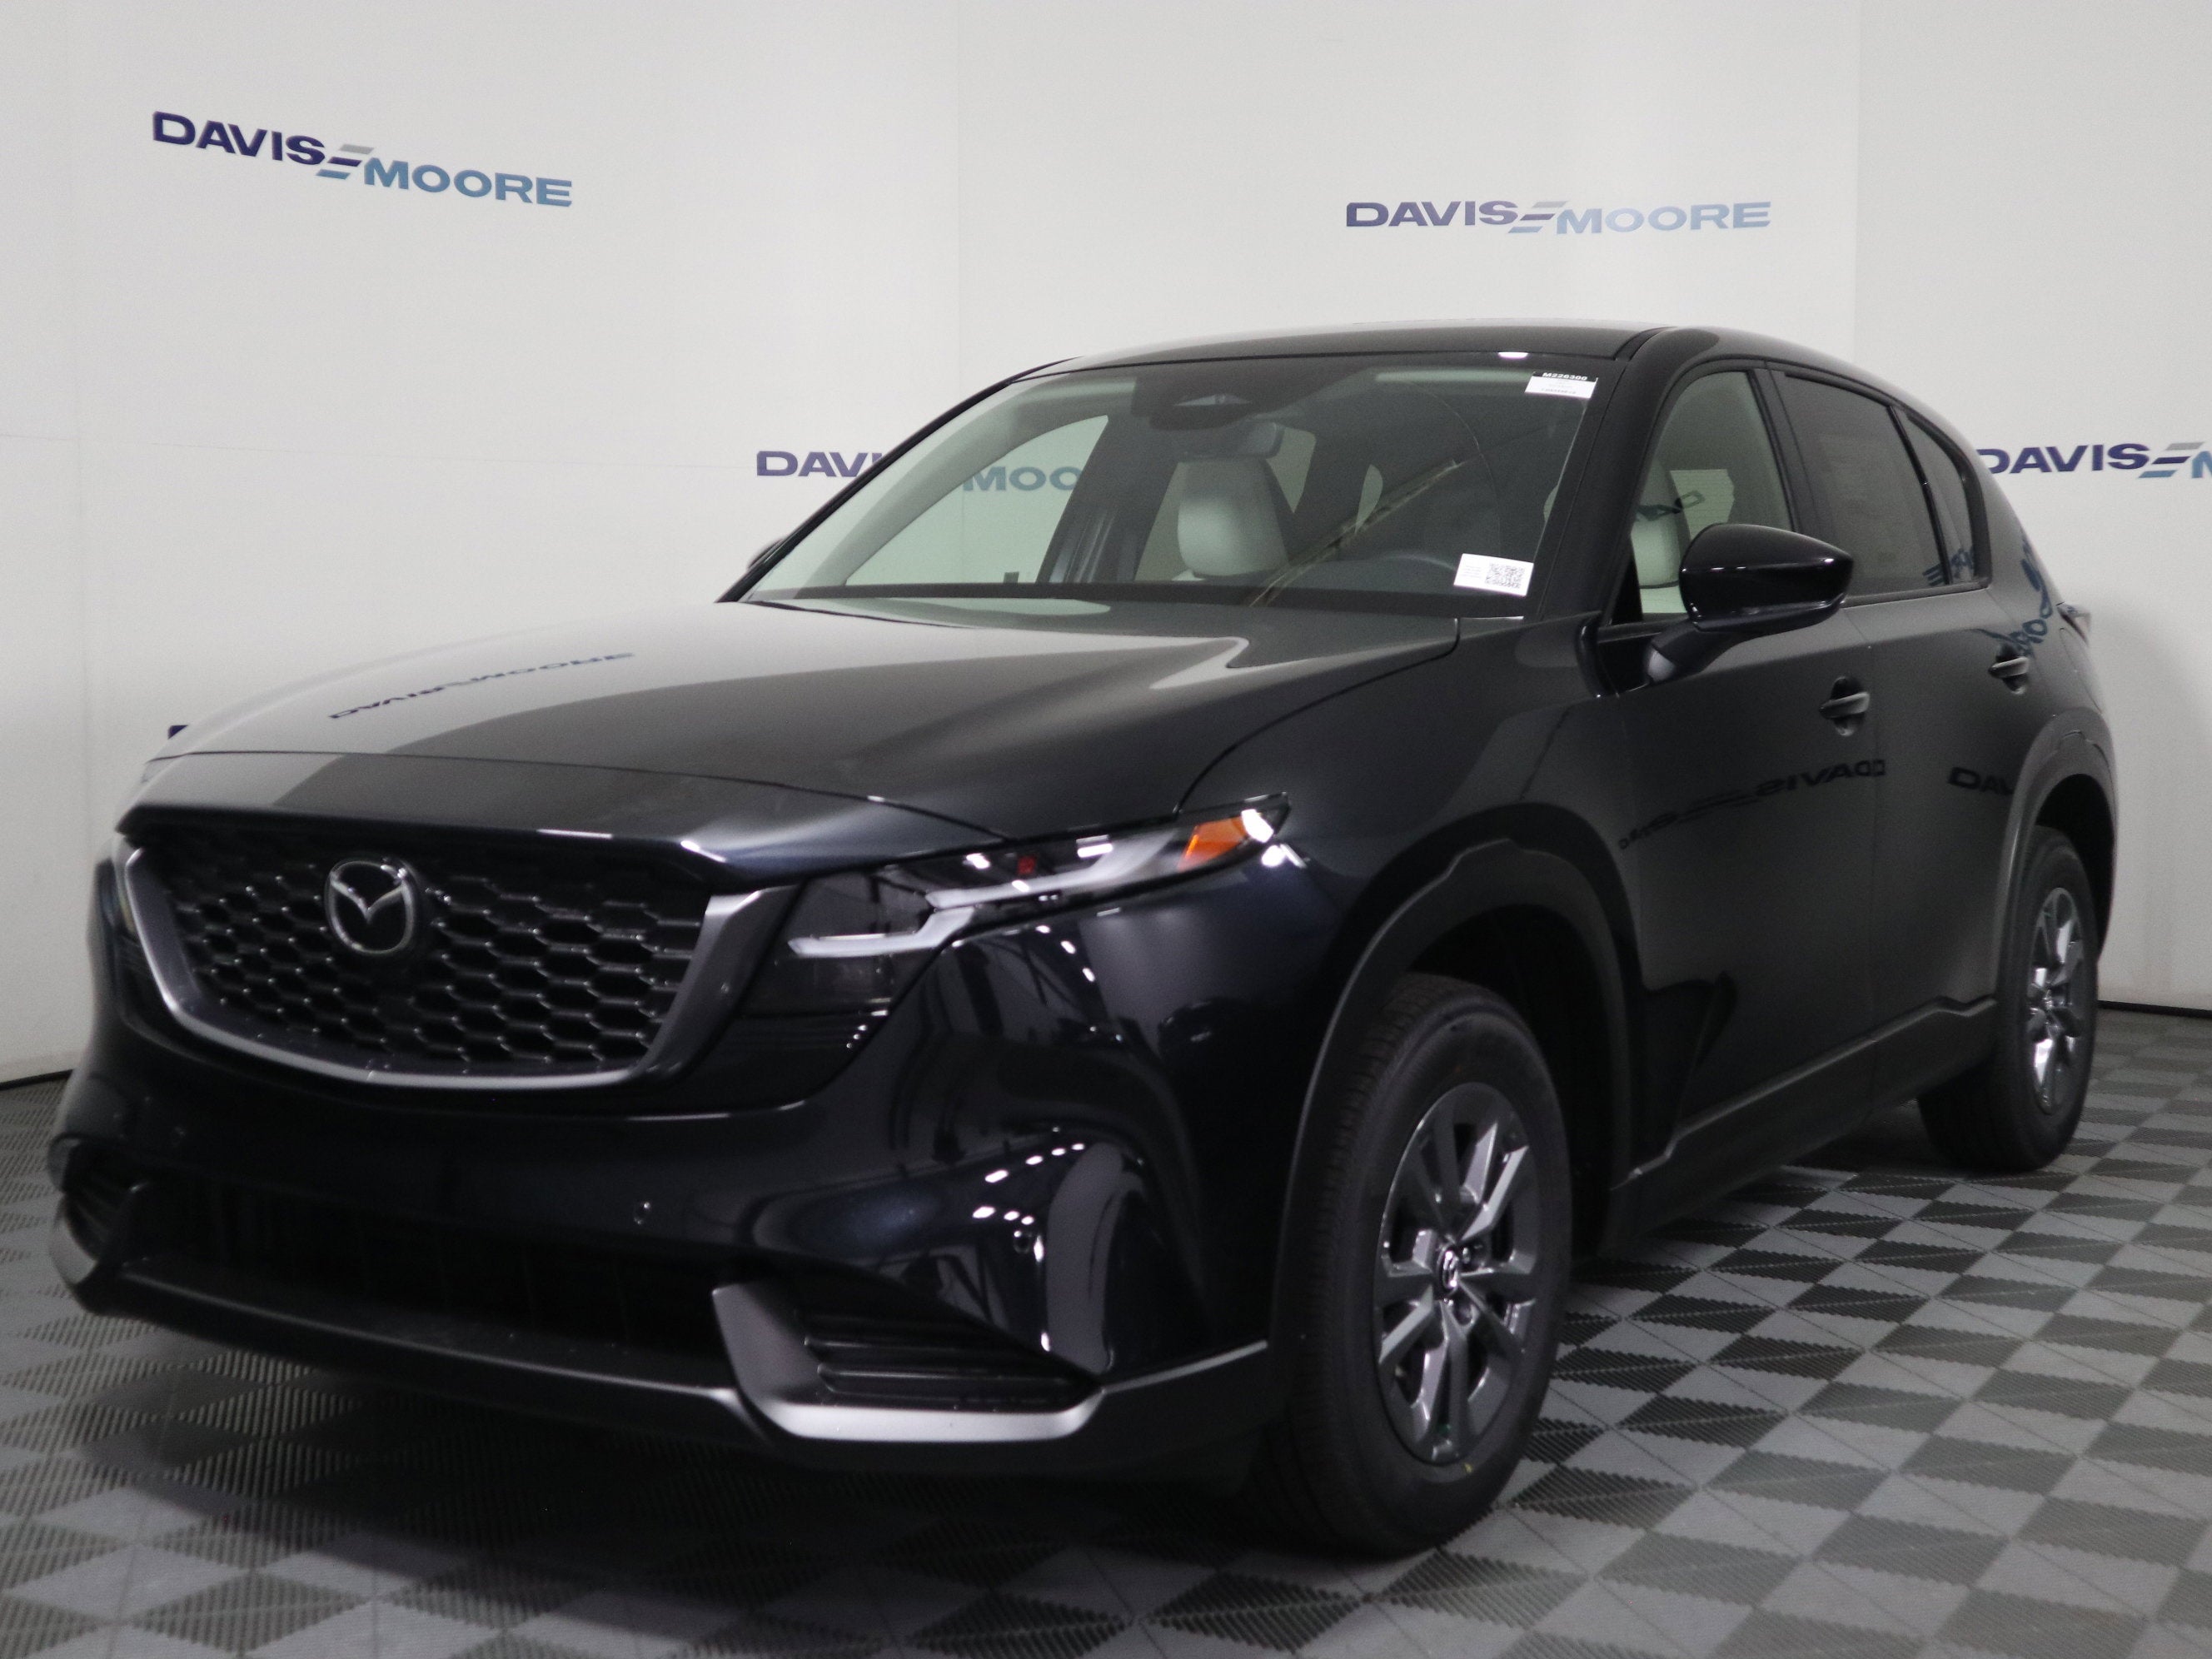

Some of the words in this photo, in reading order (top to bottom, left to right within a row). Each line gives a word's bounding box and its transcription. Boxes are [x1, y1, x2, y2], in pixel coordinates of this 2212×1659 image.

[152, 111, 326, 167] DAVIS
[364, 157, 572, 207] MOORE
[1346, 200, 1519, 227] DAVIS
[1556, 201, 1771, 235] MOORE
[1975, 443, 2151, 475] DAVIS
